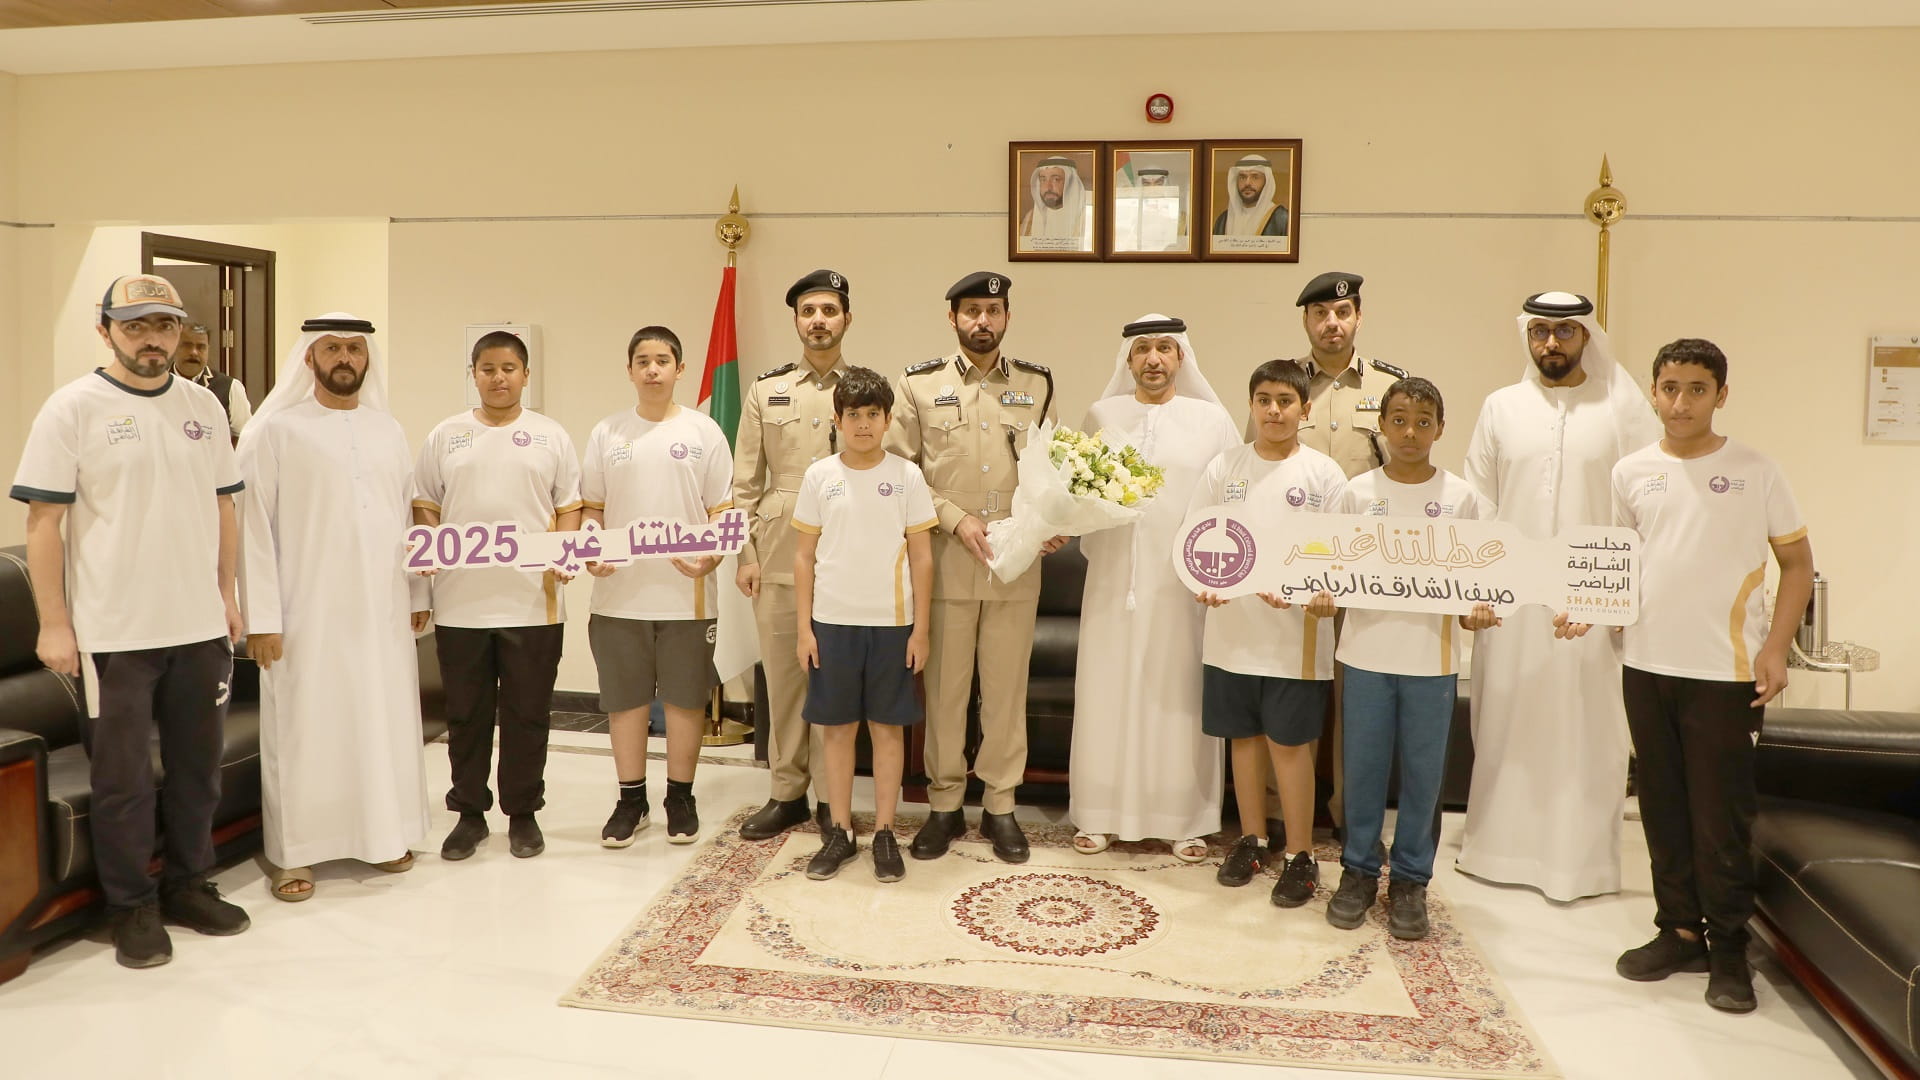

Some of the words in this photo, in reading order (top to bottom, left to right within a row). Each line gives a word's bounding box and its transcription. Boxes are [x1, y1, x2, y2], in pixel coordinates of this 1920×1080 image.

[1284, 526, 1377, 571] غير
[1377, 523, 1505, 572] عطلتنا
[1568, 537, 1631, 553] مجلس
[1567, 556, 1631, 573] الشارقة
[1281, 571, 1367, 600] الرياضي
[1369, 575, 1463, 600] الشارقة
[1464, 582, 1515, 607] صيف
[1567, 576, 1631, 594] الرياضي
[1566, 596, 1630, 608] SHARJAH
